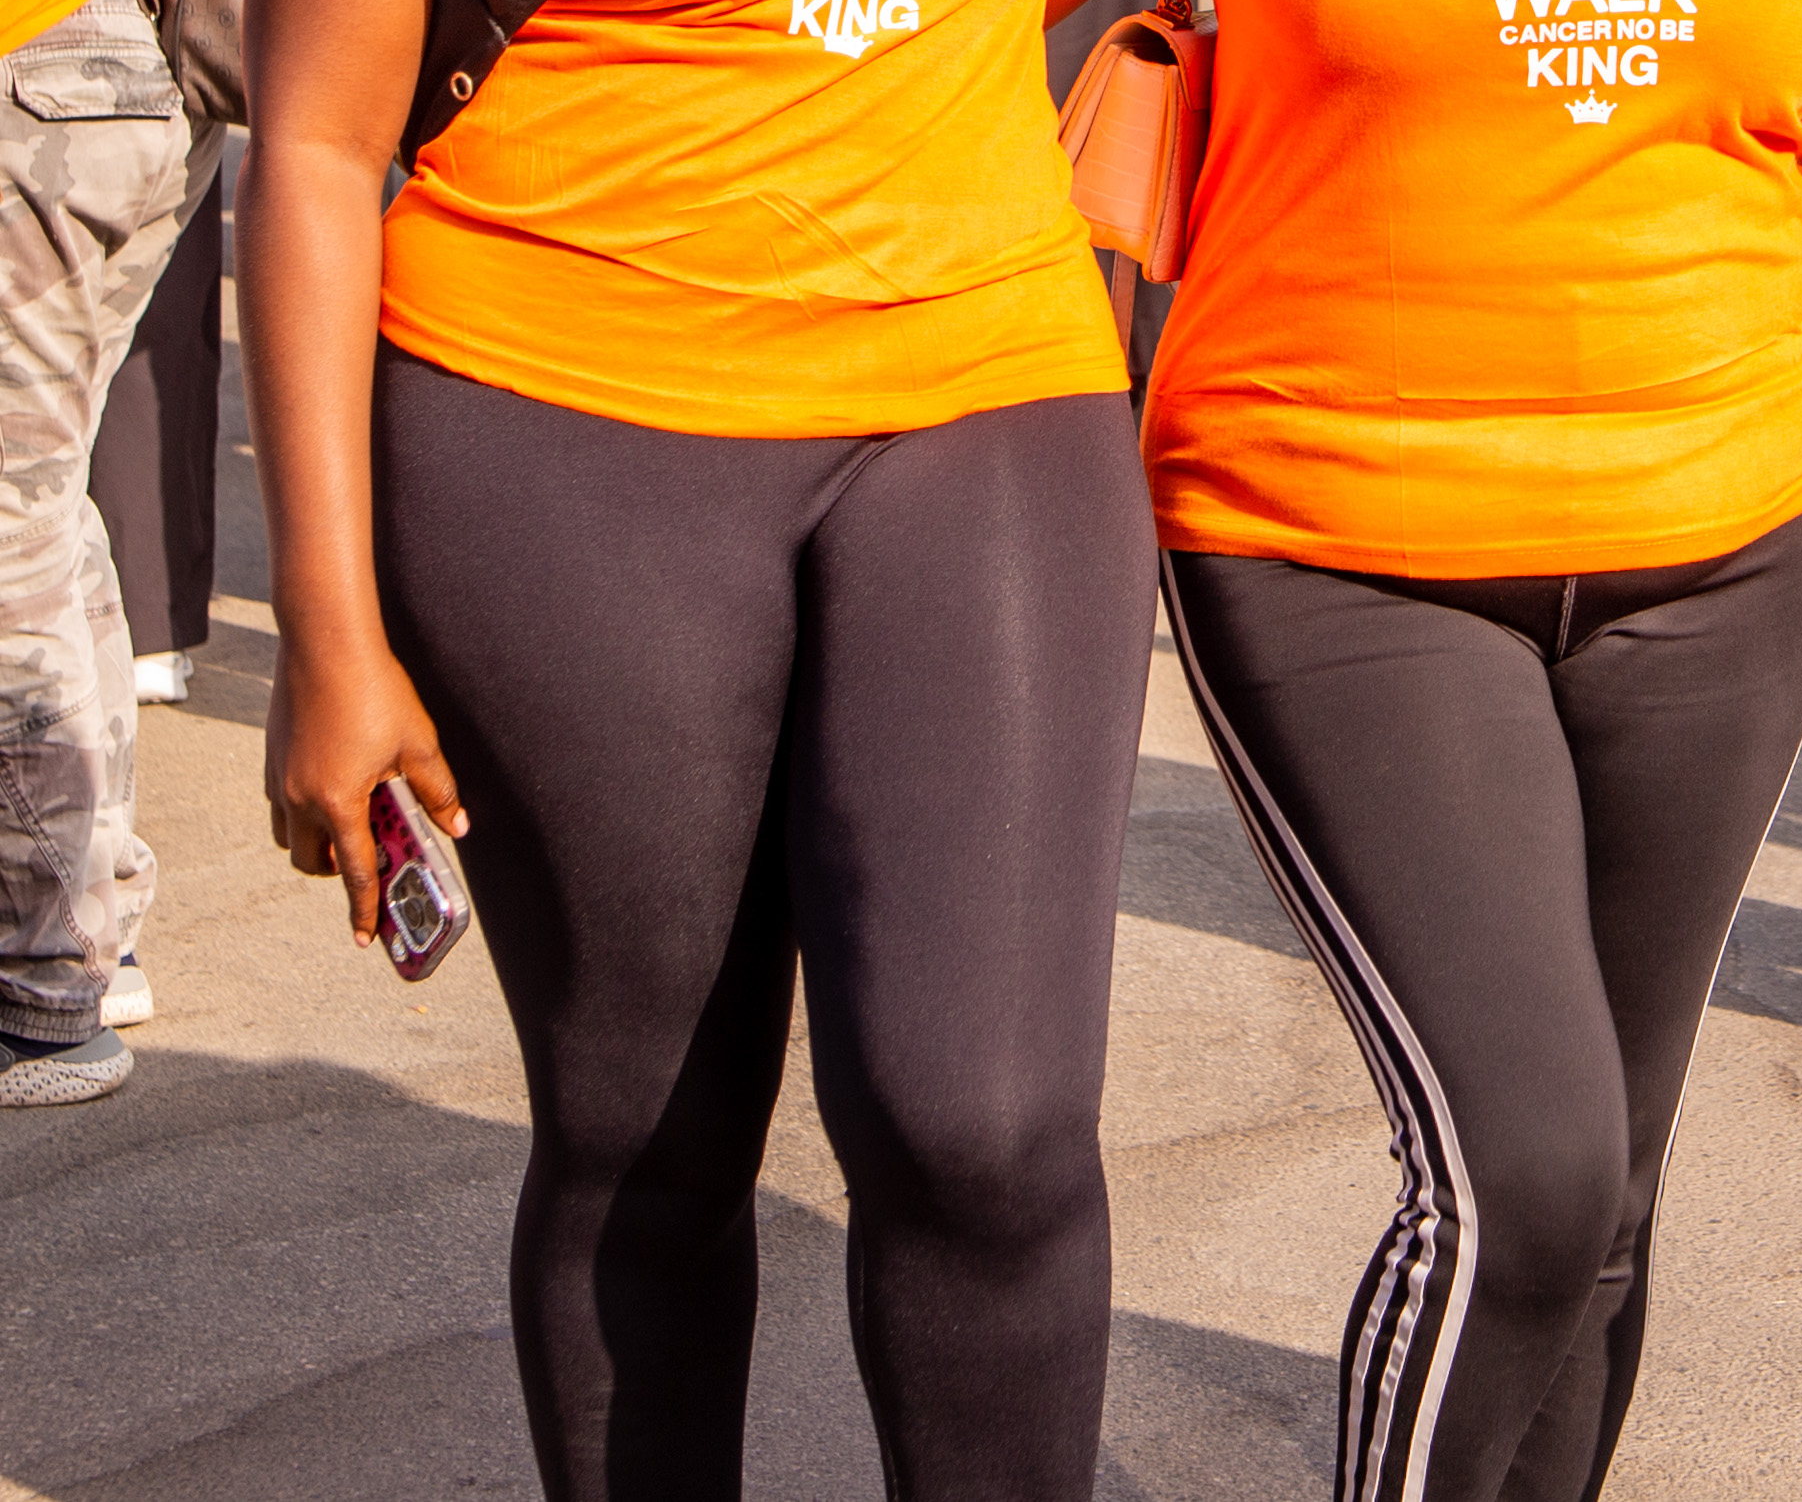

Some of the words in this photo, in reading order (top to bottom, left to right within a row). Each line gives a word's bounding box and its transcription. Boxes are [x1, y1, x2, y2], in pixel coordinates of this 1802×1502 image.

[1500, 19, 1612, 45] CANCER
[1617, 18, 1655, 39] NO
[1660, 19, 1695, 41] BE
[1528, 45, 1658, 87] KING
